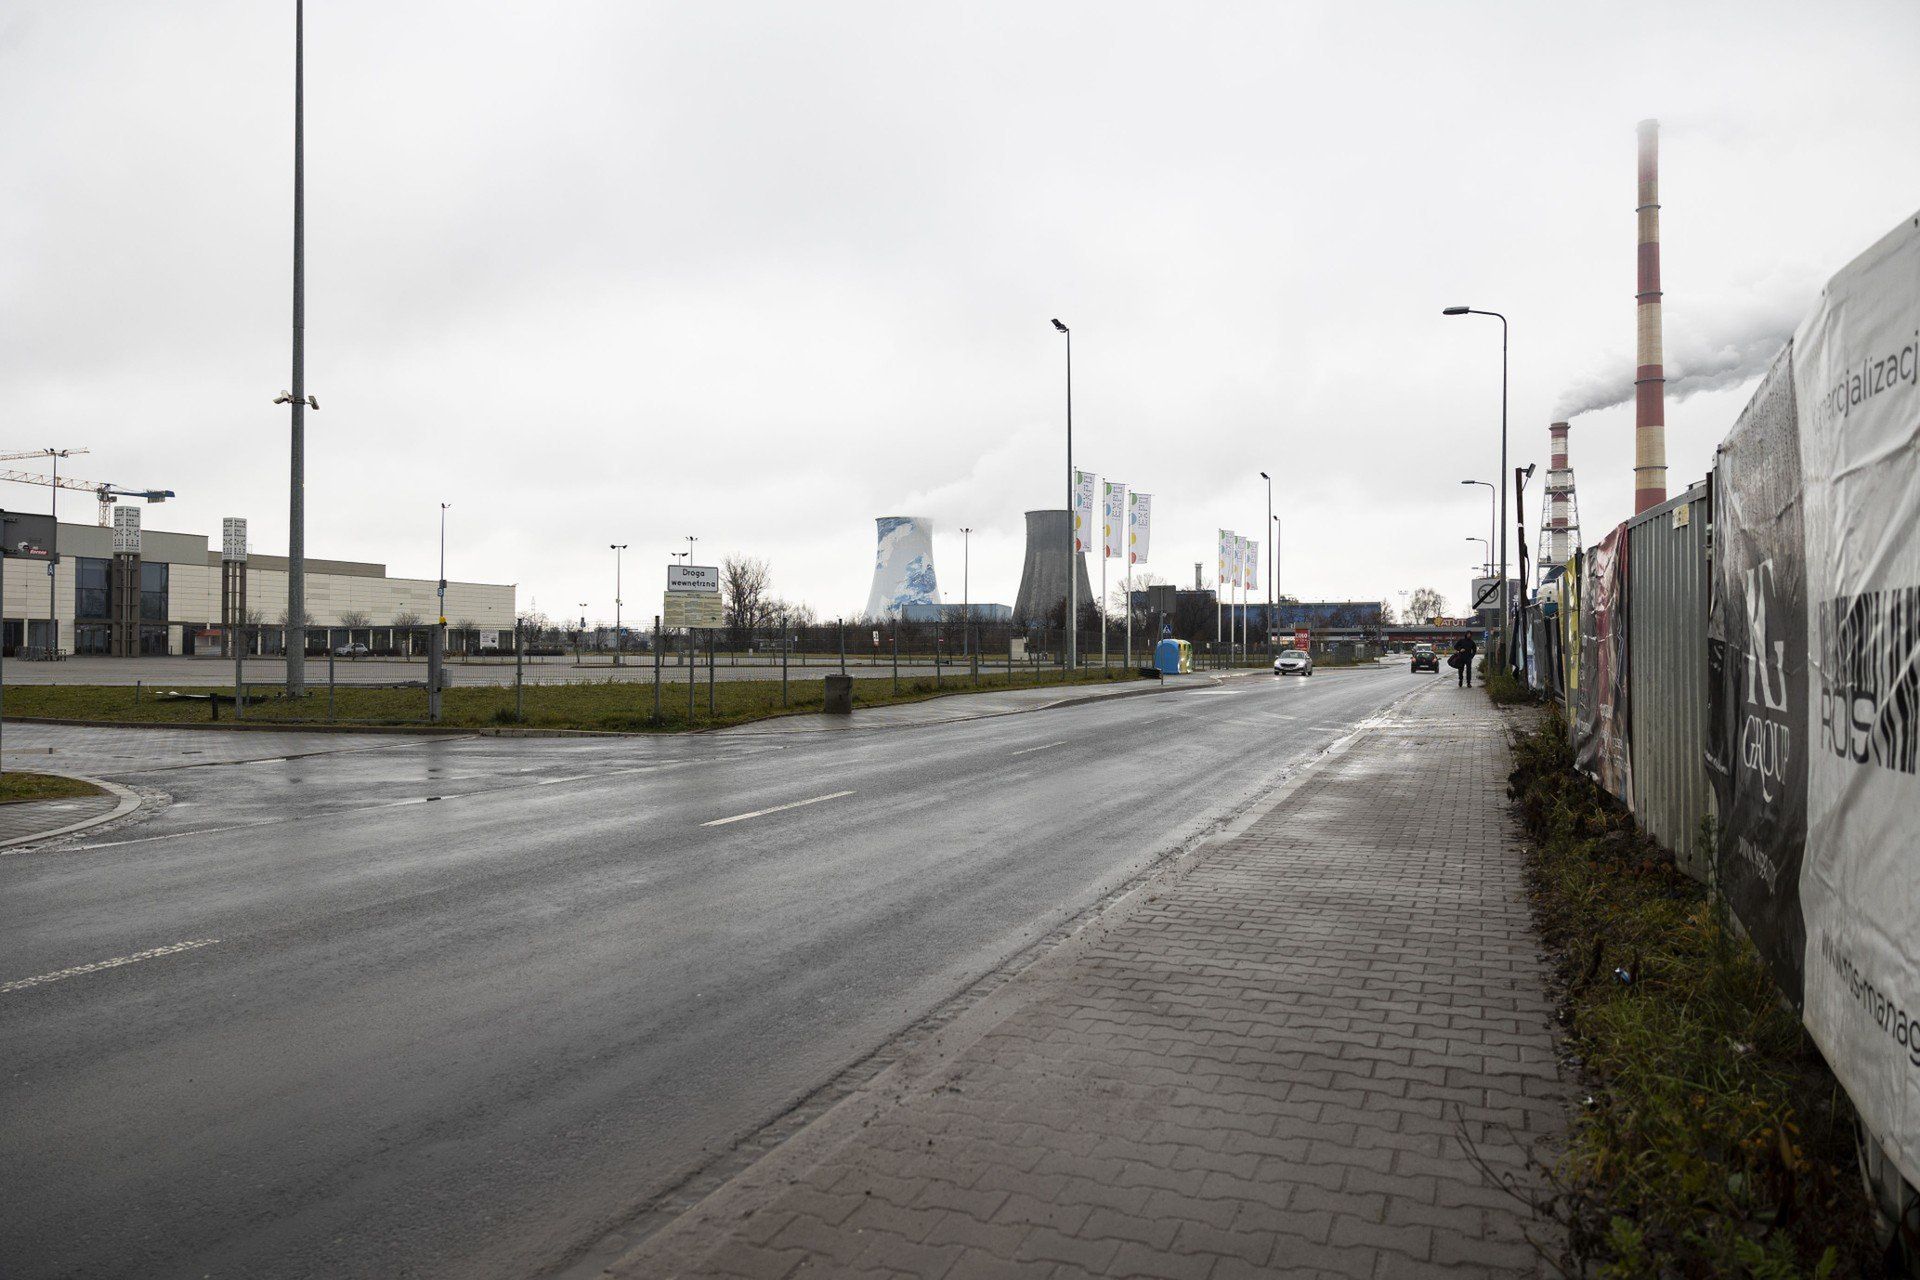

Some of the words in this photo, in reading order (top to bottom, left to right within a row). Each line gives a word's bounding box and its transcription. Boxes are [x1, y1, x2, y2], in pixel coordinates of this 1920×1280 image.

[114, 508, 124, 546] EXPO
[126, 508, 139, 547] EXPO
[671, 580, 716, 588] wewnętrzna
[682, 568, 705, 578] Droga
[1441, 618, 1467, 627] ATUT
[1743, 714, 1790, 804] GROUP
